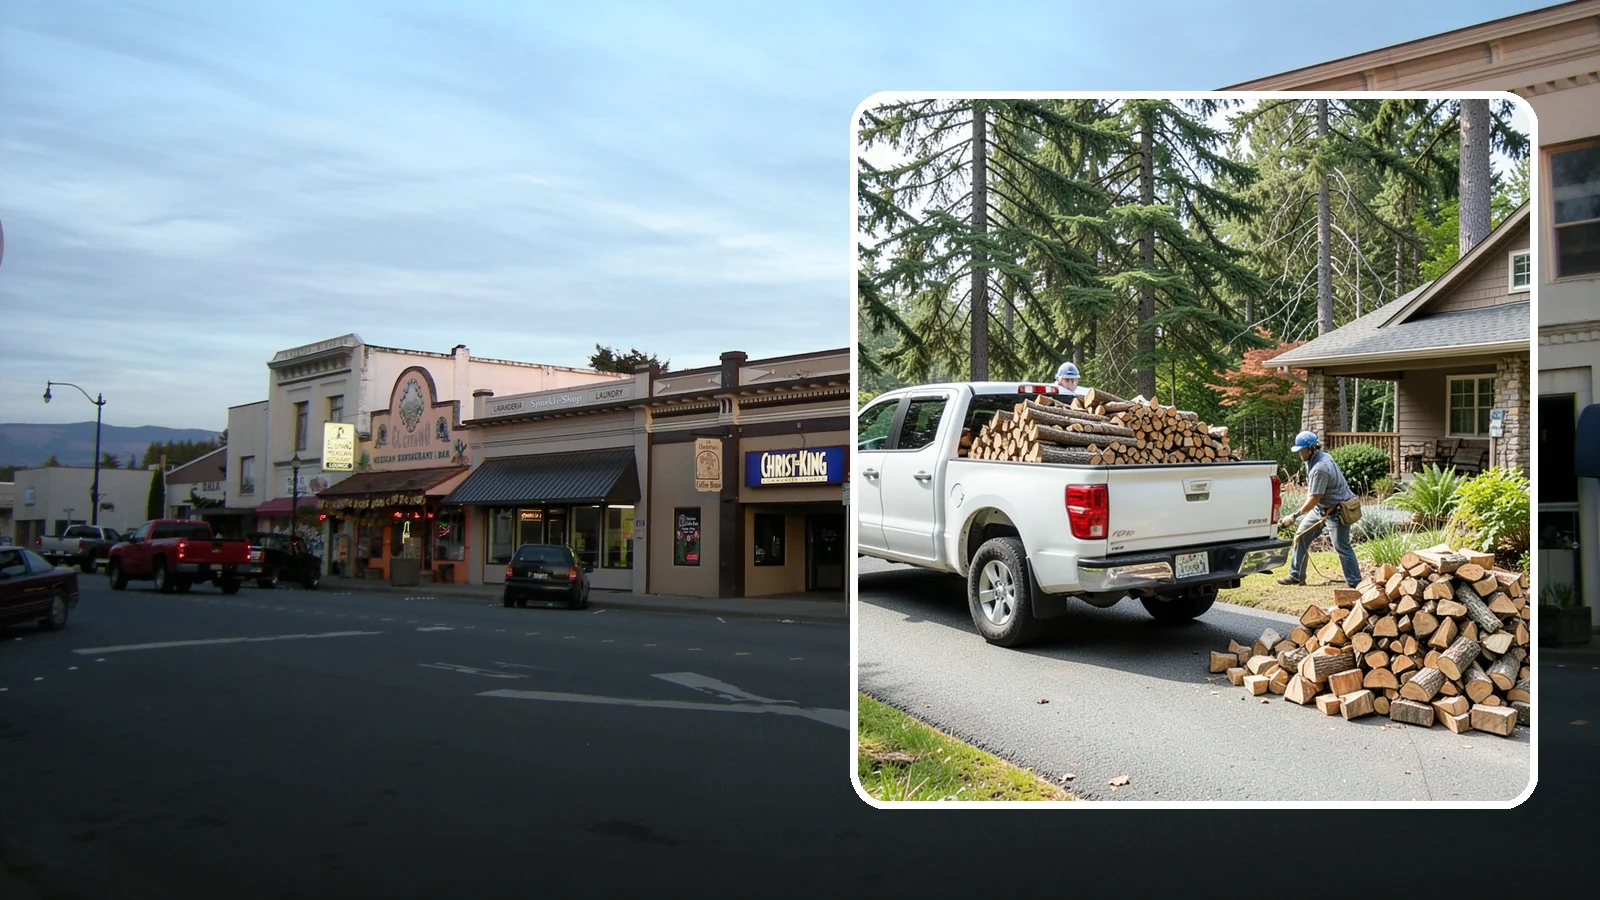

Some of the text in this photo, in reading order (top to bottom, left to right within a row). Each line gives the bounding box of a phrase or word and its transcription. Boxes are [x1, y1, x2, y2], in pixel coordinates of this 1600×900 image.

[562, 394, 582, 406] Shop
[595, 389, 624, 400] LAUNDRY
[493, 402, 522, 412] LAVANDERIA
[373, 450, 450, 464] MEXICAN RESTAURANT BAR
[760, 450, 827, 478] CHRIST KING
